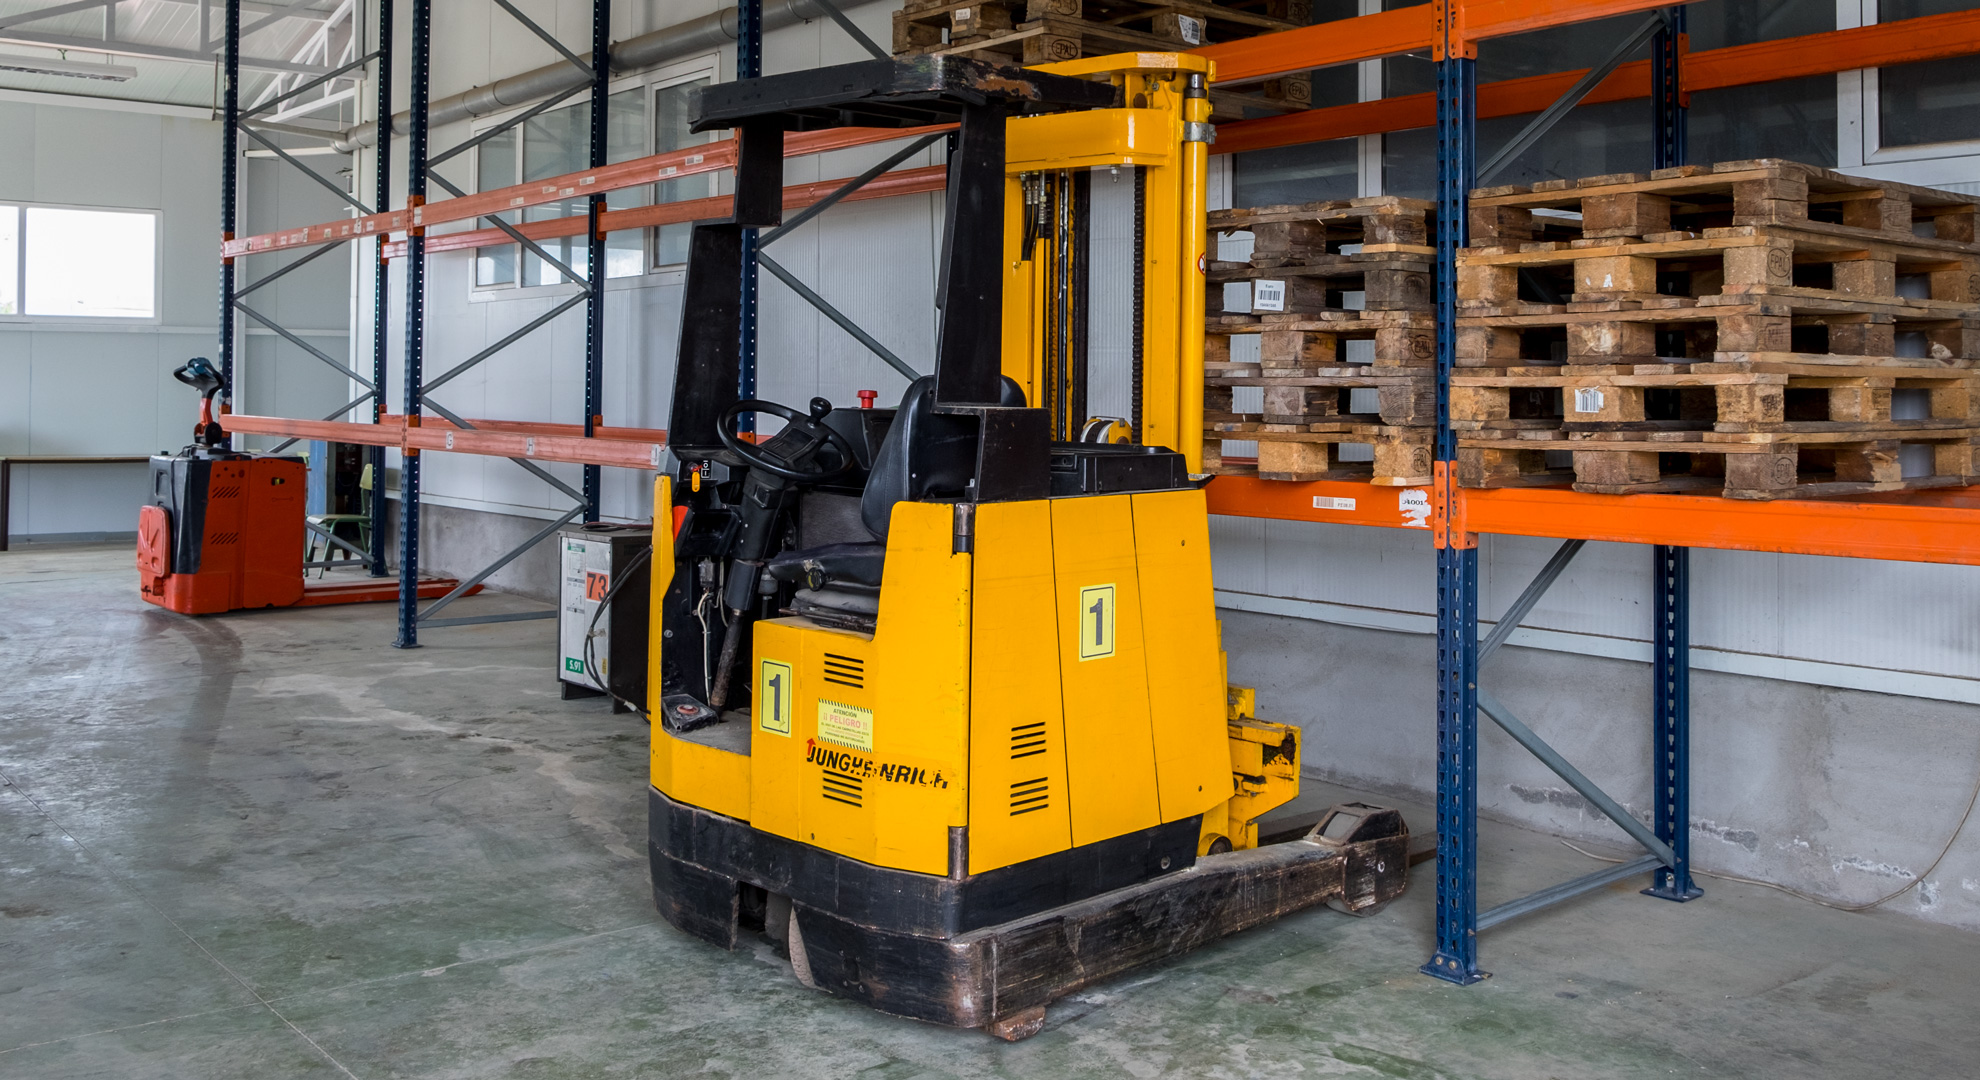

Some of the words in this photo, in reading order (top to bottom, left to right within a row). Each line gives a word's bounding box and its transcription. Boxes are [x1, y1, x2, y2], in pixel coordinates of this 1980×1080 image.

[1055, 42, 1075, 57] EPAL
[447, 433, 453, 447] G
[587, 573, 607, 601] 73
[1089, 597, 1103, 646] 1
[569, 660, 581, 671] S.91
[768, 673, 781, 722] 1
[833, 708, 857, 718] ATENCIÓN
[829, 714, 861, 729] PELIGRO
